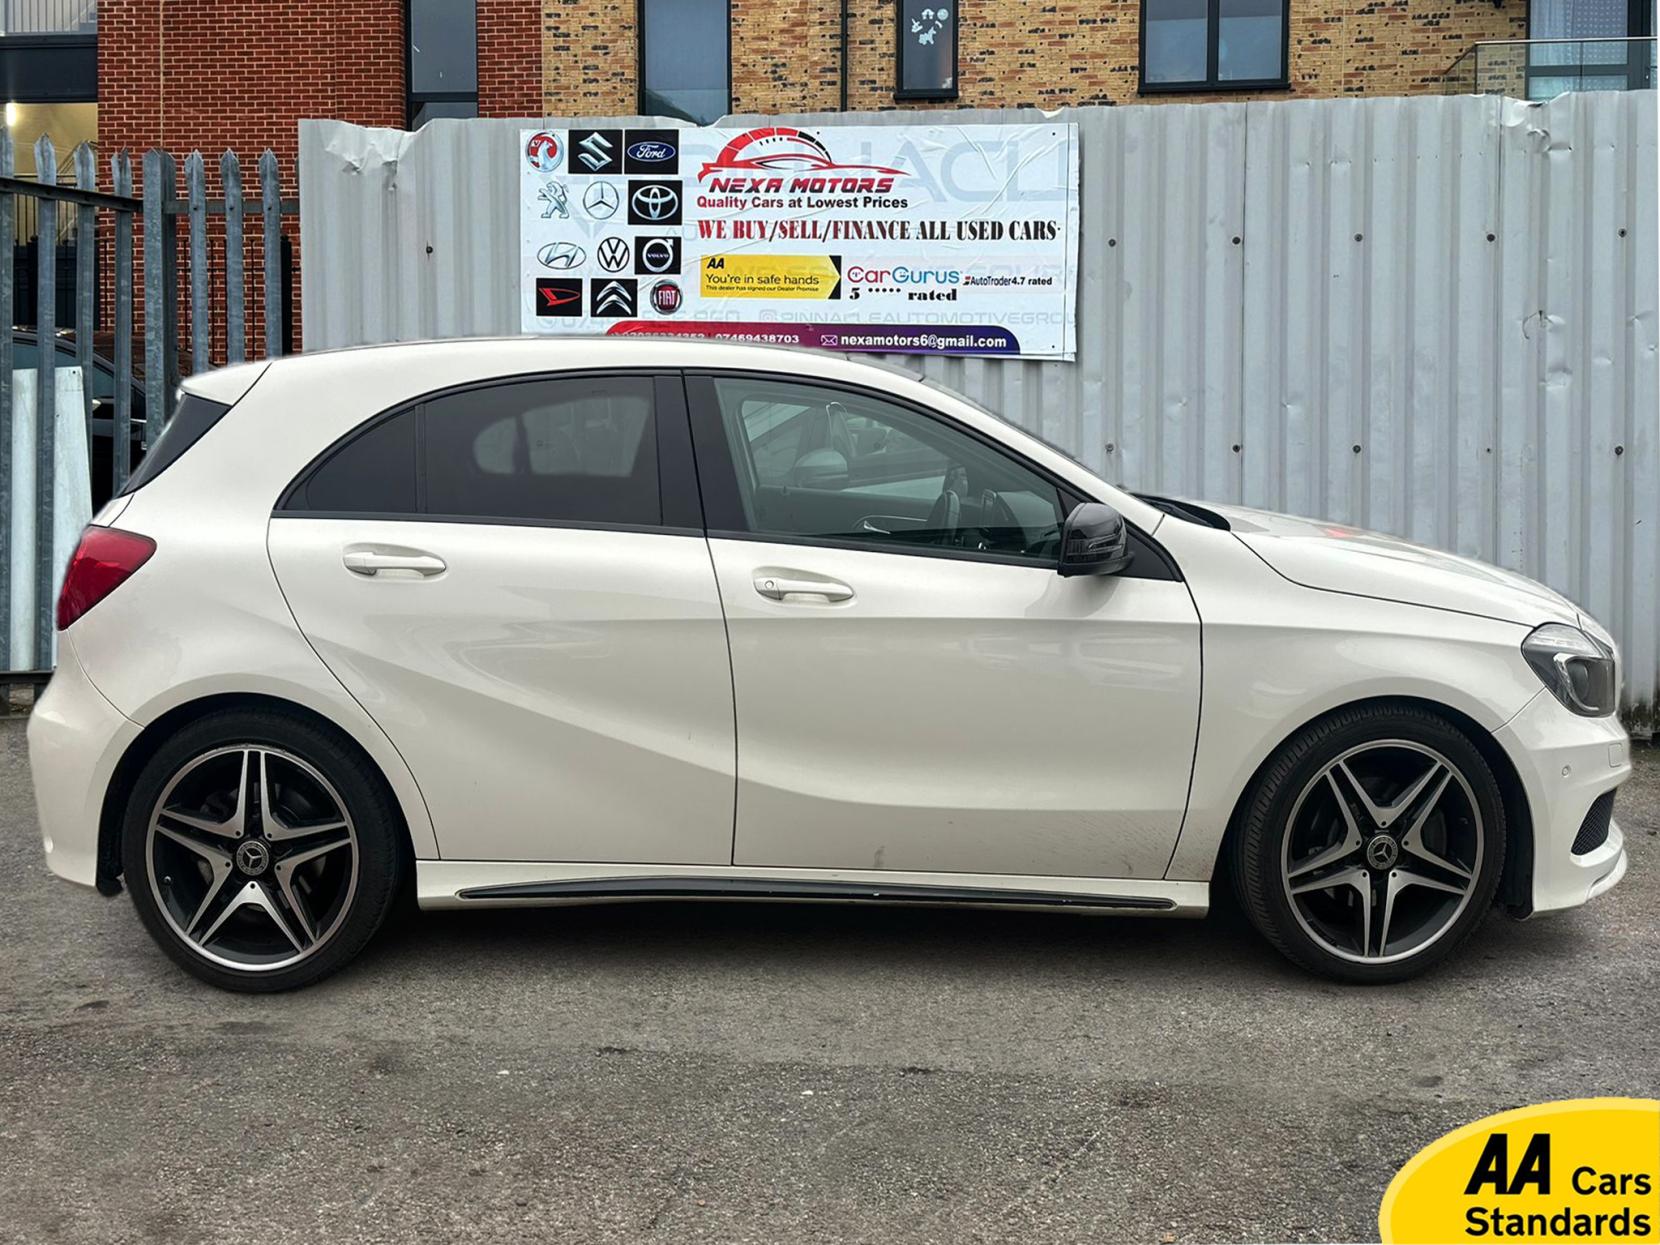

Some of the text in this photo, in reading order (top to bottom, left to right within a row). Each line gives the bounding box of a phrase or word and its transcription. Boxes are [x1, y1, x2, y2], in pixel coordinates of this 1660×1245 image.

[636, 145, 667, 158] Ford
[709, 178, 894, 193] NEXA MOTORS
[697, 195, 908, 210] Quality Cars at Lowest Prices
[697, 220, 727, 240] WE
[733, 220, 911, 242] BUY/SELL/FINANCE
[914, 221, 952, 240] ALL
[957, 221, 1004, 240] USED
[1009, 221, 1058, 240] CARS
[707, 257, 725, 269] AA
[705, 274, 741, 285] You're
[744, 274, 754, 284] in
[757, 274, 781, 285] safe
[784, 274, 820, 285] hands
[847, 266, 960, 283] CarGurus
[970, 276, 1011, 286] AutoTrader
[1011, 277, 1025, 285] 4.7
[1028, 277, 1053, 285] rated
[658, 291, 676, 305] FIAT
[849, 288, 957, 301] 5 rated
[841, 335, 1007, 350] nexamotors6@gmail.com
